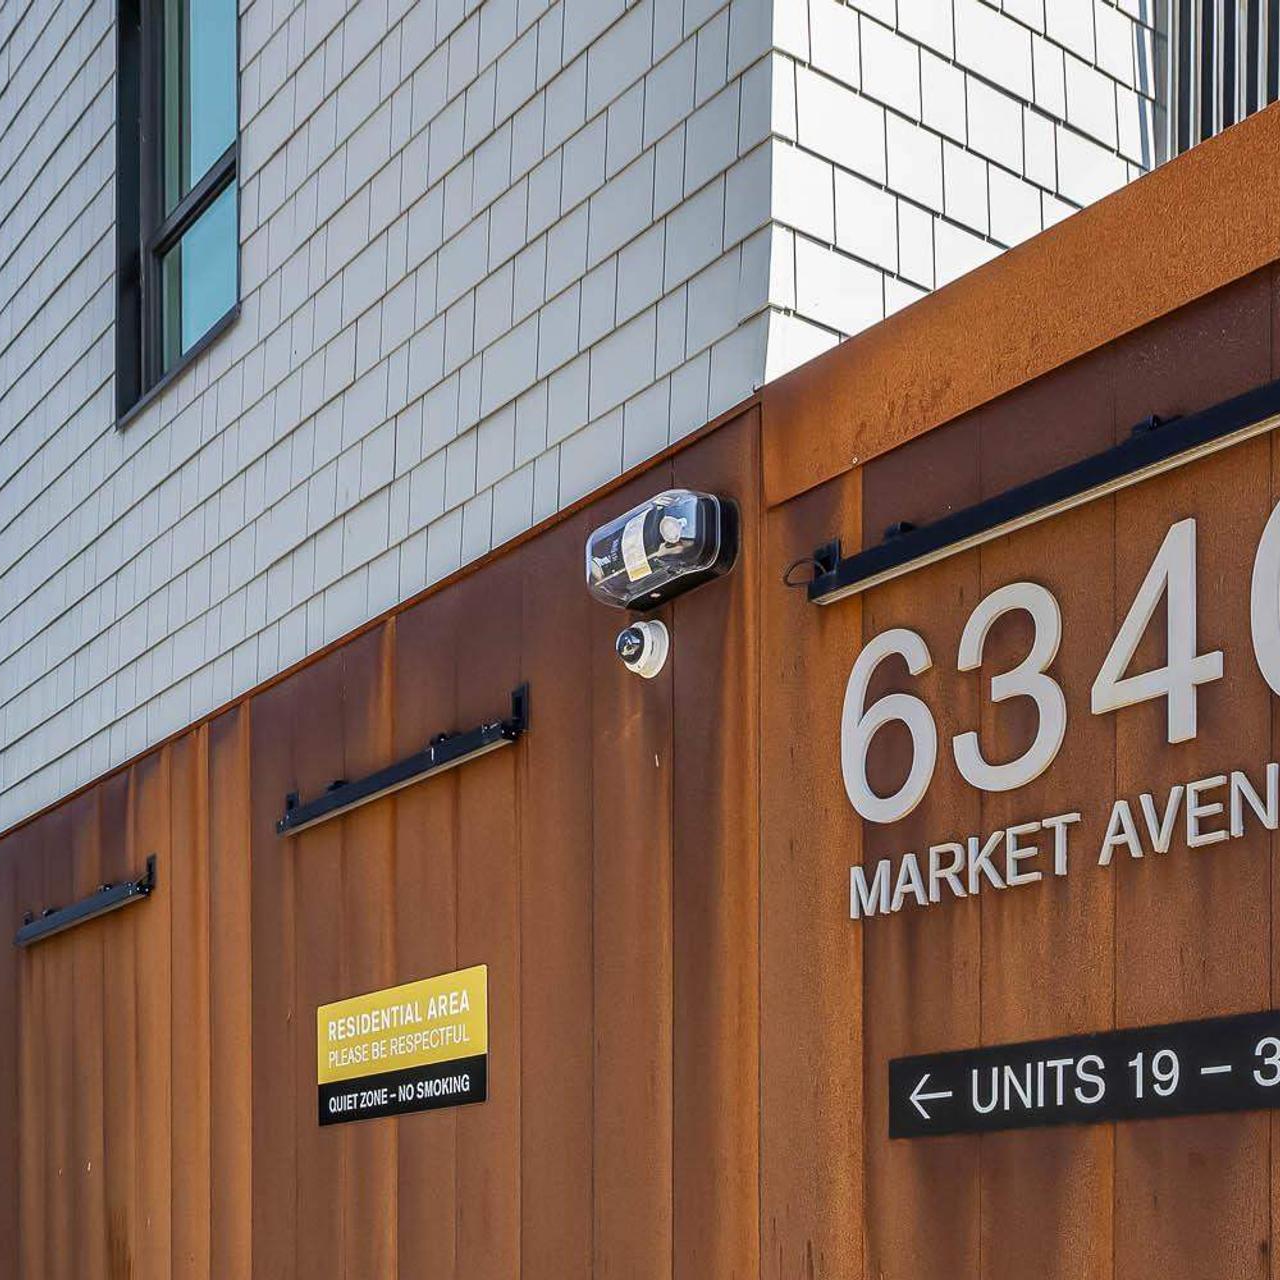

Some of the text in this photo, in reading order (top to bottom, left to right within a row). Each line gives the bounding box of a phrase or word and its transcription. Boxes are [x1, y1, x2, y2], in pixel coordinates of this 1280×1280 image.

[849, 812, 1081, 919] MARKET
[328, 989, 470, 1042] RESIDENTIAL AREA
[328, 1023, 470, 1069] PLEASE BE RESPECTFUL
[328, 1093, 359, 1114] QUIET
[359, 1087, 388, 1108] ZONE
[398, 1083, 414, 1102] NO
[416, 1073, 470, 1099] SMOKING
[970, 1054, 1106, 1114] UNITS
[1127, 1049, 1180, 1099] 19
